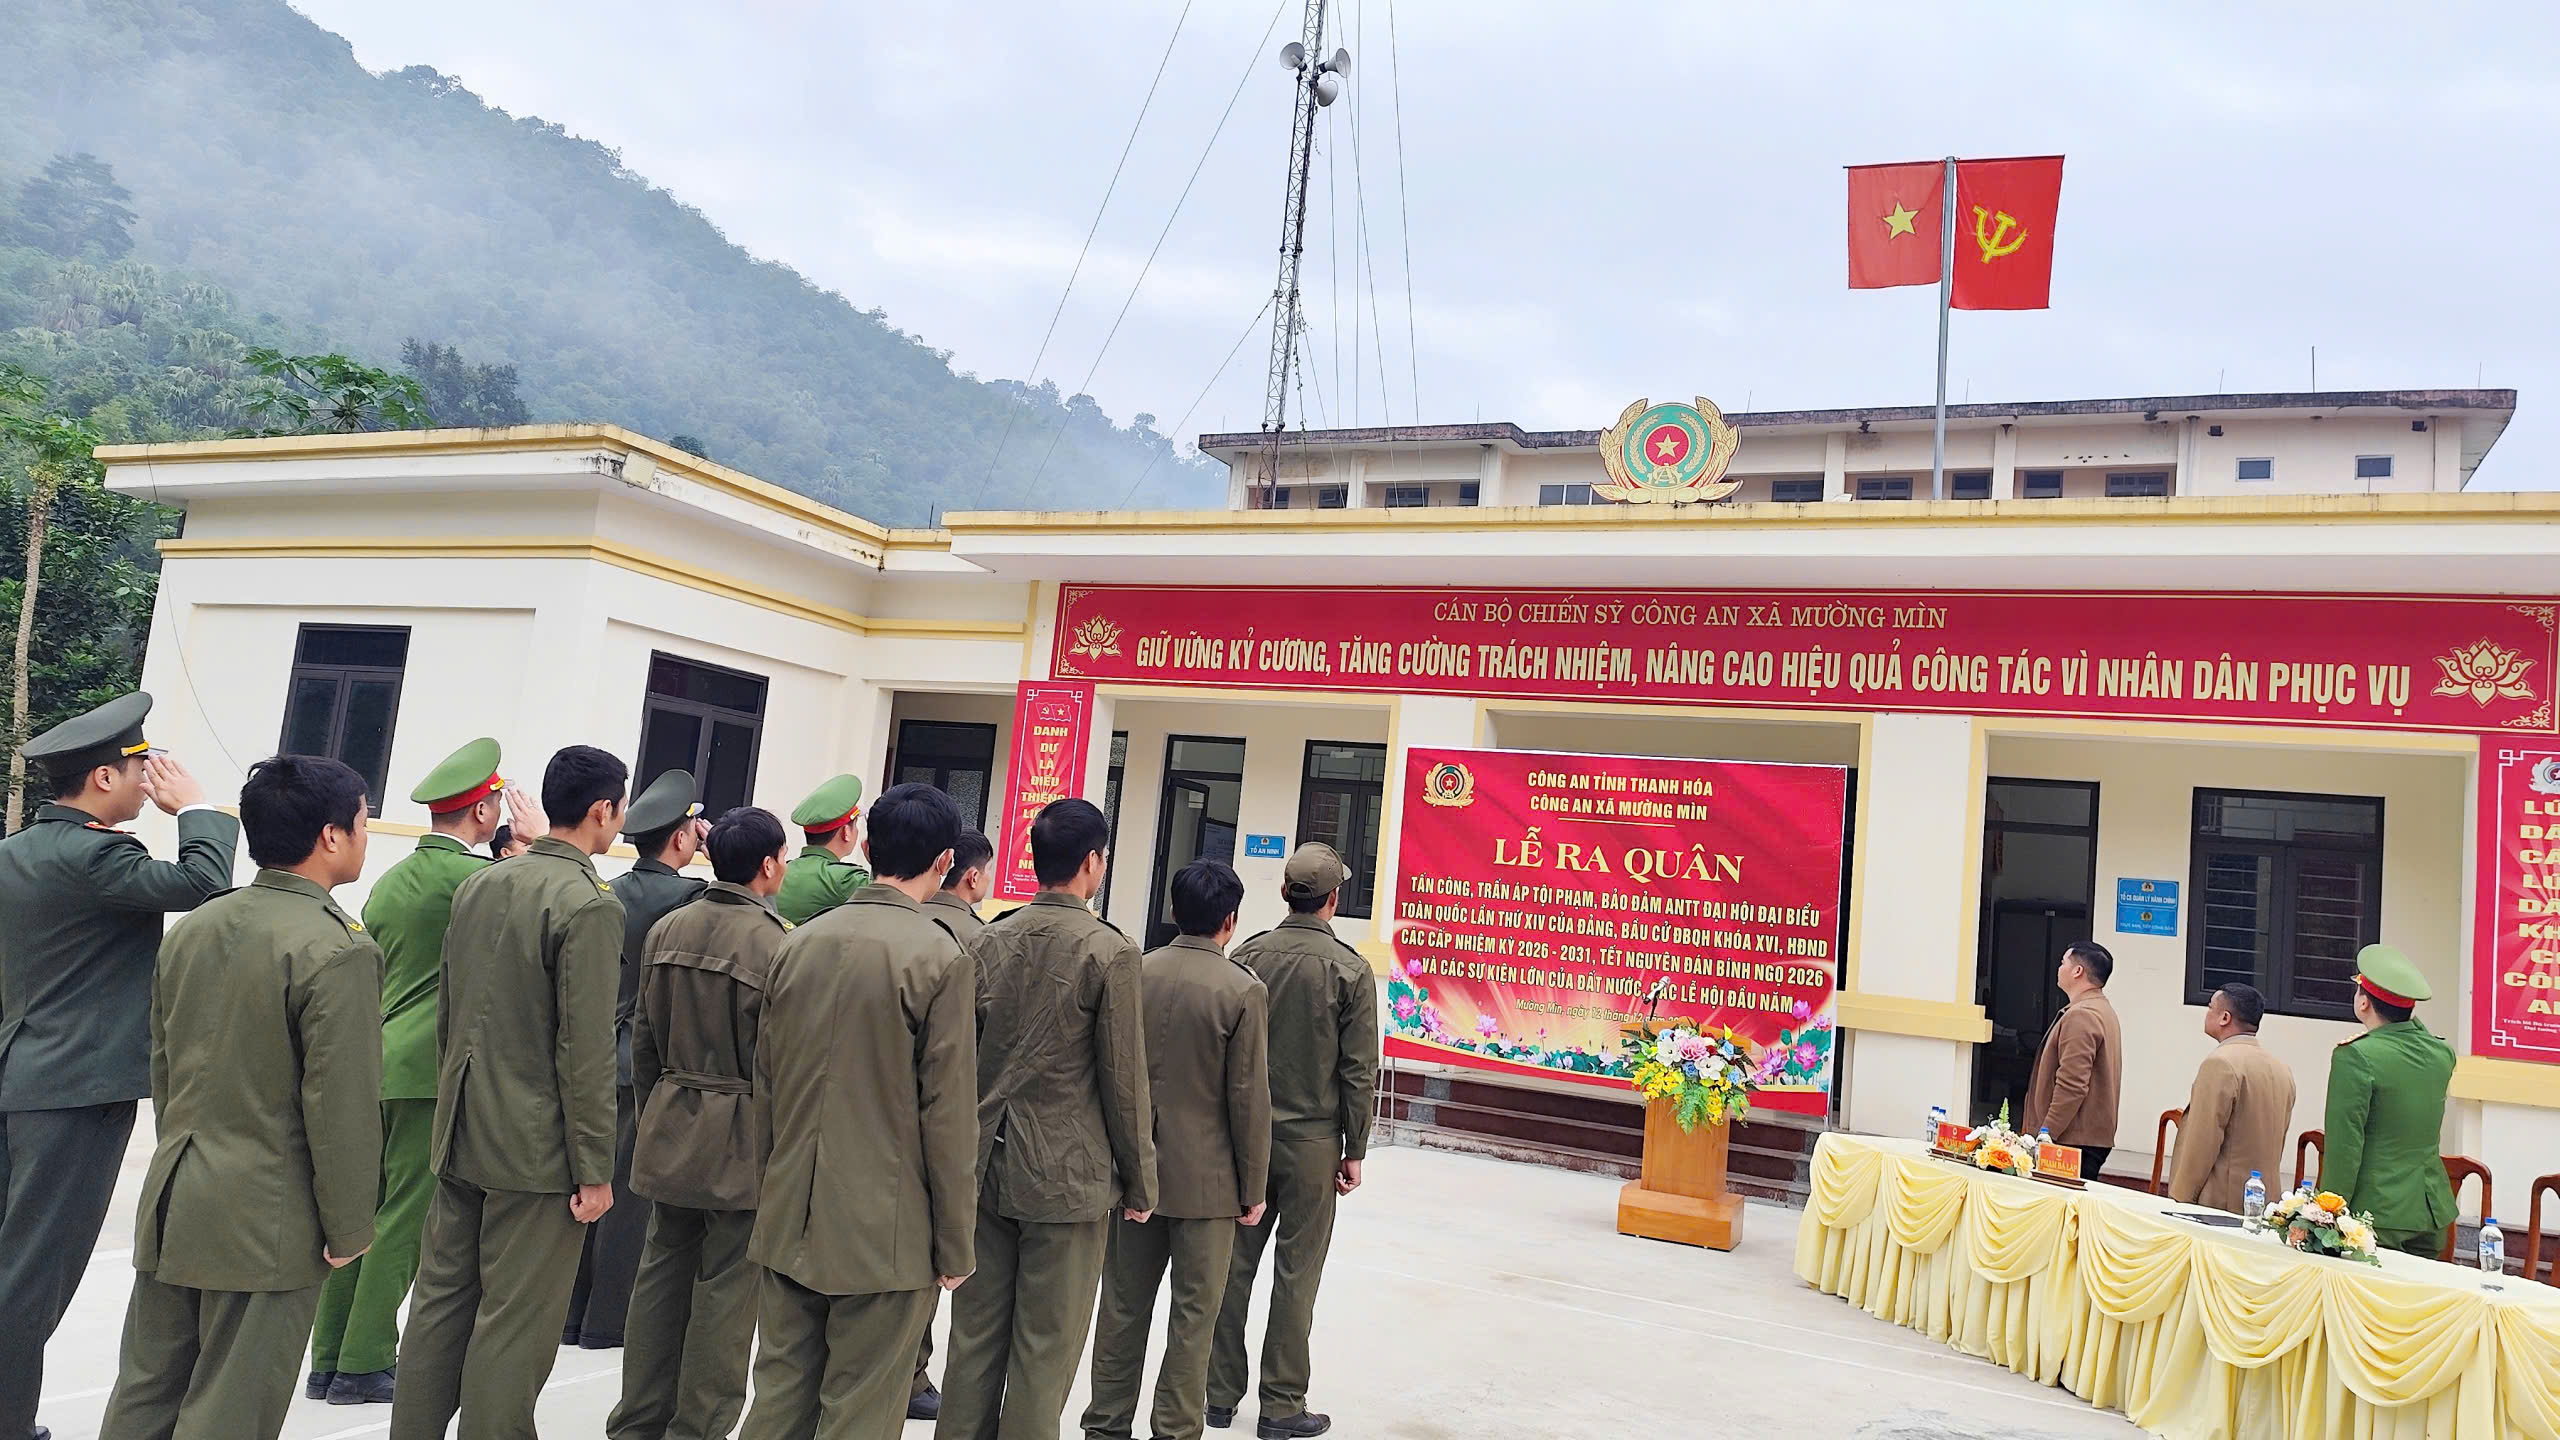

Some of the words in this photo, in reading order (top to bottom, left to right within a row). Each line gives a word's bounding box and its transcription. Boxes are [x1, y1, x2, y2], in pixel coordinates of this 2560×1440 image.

[1434, 597, 1478, 622] CÁN
[1483, 597, 1513, 627] BỘ
[1518, 595, 1589, 624] CHIẾN
[1594, 600, 1624, 624] SỸ
[1631, 599, 1697, 625] CÔNG
[1704, 605, 1740, 626] AN
[1746, 602, 1783, 627] XÃ
[1790, 600, 1886, 628] MƯỜNG
[1892, 601, 1948, 628] MÌN
[1136, 630, 1172, 667] GIỮ
[1173, 631, 1223, 669] VỮNG
[1228, 626, 1254, 670] KỶ
[1259, 637, 1331, 677] CƯƠNG,
[1339, 634, 1392, 674] TĂNG
[1398, 634, 1470, 677] CƯỜNG
[1477, 638, 1549, 679] TRÁCH
[1554, 641, 1638, 688] NHIỆM,
[1645, 642, 1715, 685] NÂNG
[1722, 650, 1774, 687] CAO
[1781, 644, 1841, 696] HIỆU
[1849, 638, 1903, 693] QUẢ
[1912, 646, 1989, 693] CÔNG
[1997, 648, 2051, 695] TÁC
[2061, 650, 2088, 696] VÌ
[2097, 651, 2184, 699] NHÂN
[2192, 652, 2259, 702] DÂN
[2268, 662, 2356, 713] PHỤC
[2367, 664, 2411, 716] VỤ
[1033, 726, 1068, 736] DANH
[1040, 743, 1060, 755] DỰ
[1039, 758, 1055, 770] LÀ
[1527, 769, 1567, 788] CÔNG
[1569, 774, 1590, 790] AN
[1593, 771, 1627, 792] TỈNH
[1630, 777, 1679, 795] THANH
[1682, 777, 1713, 796] HÓA
[1530, 794, 1569, 812] CÔNG
[1572, 798, 1592, 814] AN
[1595, 797, 1615, 815] XÃ
[1618, 800, 1673, 819] MƯỜNG
[1676, 801, 1708, 820] MÌN
[2524, 799, 2560, 816] LÚ
[2520, 824, 2560, 840] DÂ
[1493, 826, 1544, 868] LỄ
[1555, 843, 1611, 873] RA
[1623, 843, 1745, 884] QUÂN
[2523, 873, 2560, 890] LÚ
[1411, 872, 1434, 894] TẤN
[1436, 877, 1474, 899] CÔNG,
[1477, 878, 1510, 900] TRẤN
[1512, 881, 1530, 901] ÁP
[1532, 885, 1553, 907] TỘI
[1555, 888, 1598, 910] PHẠM,
[1601, 888, 1628, 911] BẢO
[1631, 889, 1662, 914] ĐẢM
[1665, 897, 1700, 917] ANTT
[1702, 900, 1726, 923] ĐẠI
[1730, 900, 1754, 925] HỘI
[1758, 905, 1782, 928] ĐẠI
[1785, 902, 1820, 928] BIỂU
[2518, 898, 2560, 914] DÂ
[1401, 900, 1433, 920] TOÀN
[1435, 901, 1468, 924] QUỐC
[1470, 904, 1495, 927] LẦN
[1498, 908, 1524, 929] THỨ
[1524, 914, 1545, 931] XIV
[1548, 911, 1574, 934] CỦA
[1577, 913, 1618, 940] ĐẢNG,
[1621, 917, 1648, 941] BẦU
[1651, 920, 1671, 943] CỬ
[1673, 927, 1710, 948] ĐBQH
[1714, 928, 1751, 951] KHÓA
[1755, 934, 1783, 956] XVI,
[1787, 937, 1828, 959] HĐND
[2519, 923, 2560, 940] KH
[1400, 926, 1425, 946] CÁC
[1427, 926, 1453, 949] CẤP
[1455, 932, 1496, 955] NHIỆM
[1498, 937, 1515, 955] KỲ
[1517, 940, 1549, 959] 2026
[1560, 944, 1596, 965] 2031,
[1600, 943, 1622, 967] TẾT
[1625, 948, 1681, 973] NGUYÊN
[1683, 955, 1713, 976] ĐÁN
[1716, 957, 1750, 979] BÍNH
[1754, 963, 1784, 987] NGỌ
[1787, 967, 1824, 988] 2026
[2531, 949, 2560, 964] C
[1422, 955, 1437, 975] VÀ
[1440, 957, 1465, 977] CÁC
[1467, 962, 1486, 983] SỰ
[1486, 963, 1518, 986] KIỆN
[1520, 965, 1545, 986] LỚN
[1548, 967, 1574, 989] CỦA
[1577, 971, 1602, 995] ĐẤT
[1680, 979, 1697, 1003] LỄ
[1700, 984, 1723, 1009] HỘI
[1727, 985, 1756, 1010] ĐẦU
[1759, 991, 1794, 1014] NĂM
[2504, 971, 2560, 990] CÔ
[1515, 998, 1545, 1015] Mường
[1566, 1004, 1589, 1020] ngày
[1604, 1008, 1629, 1022] tháng
